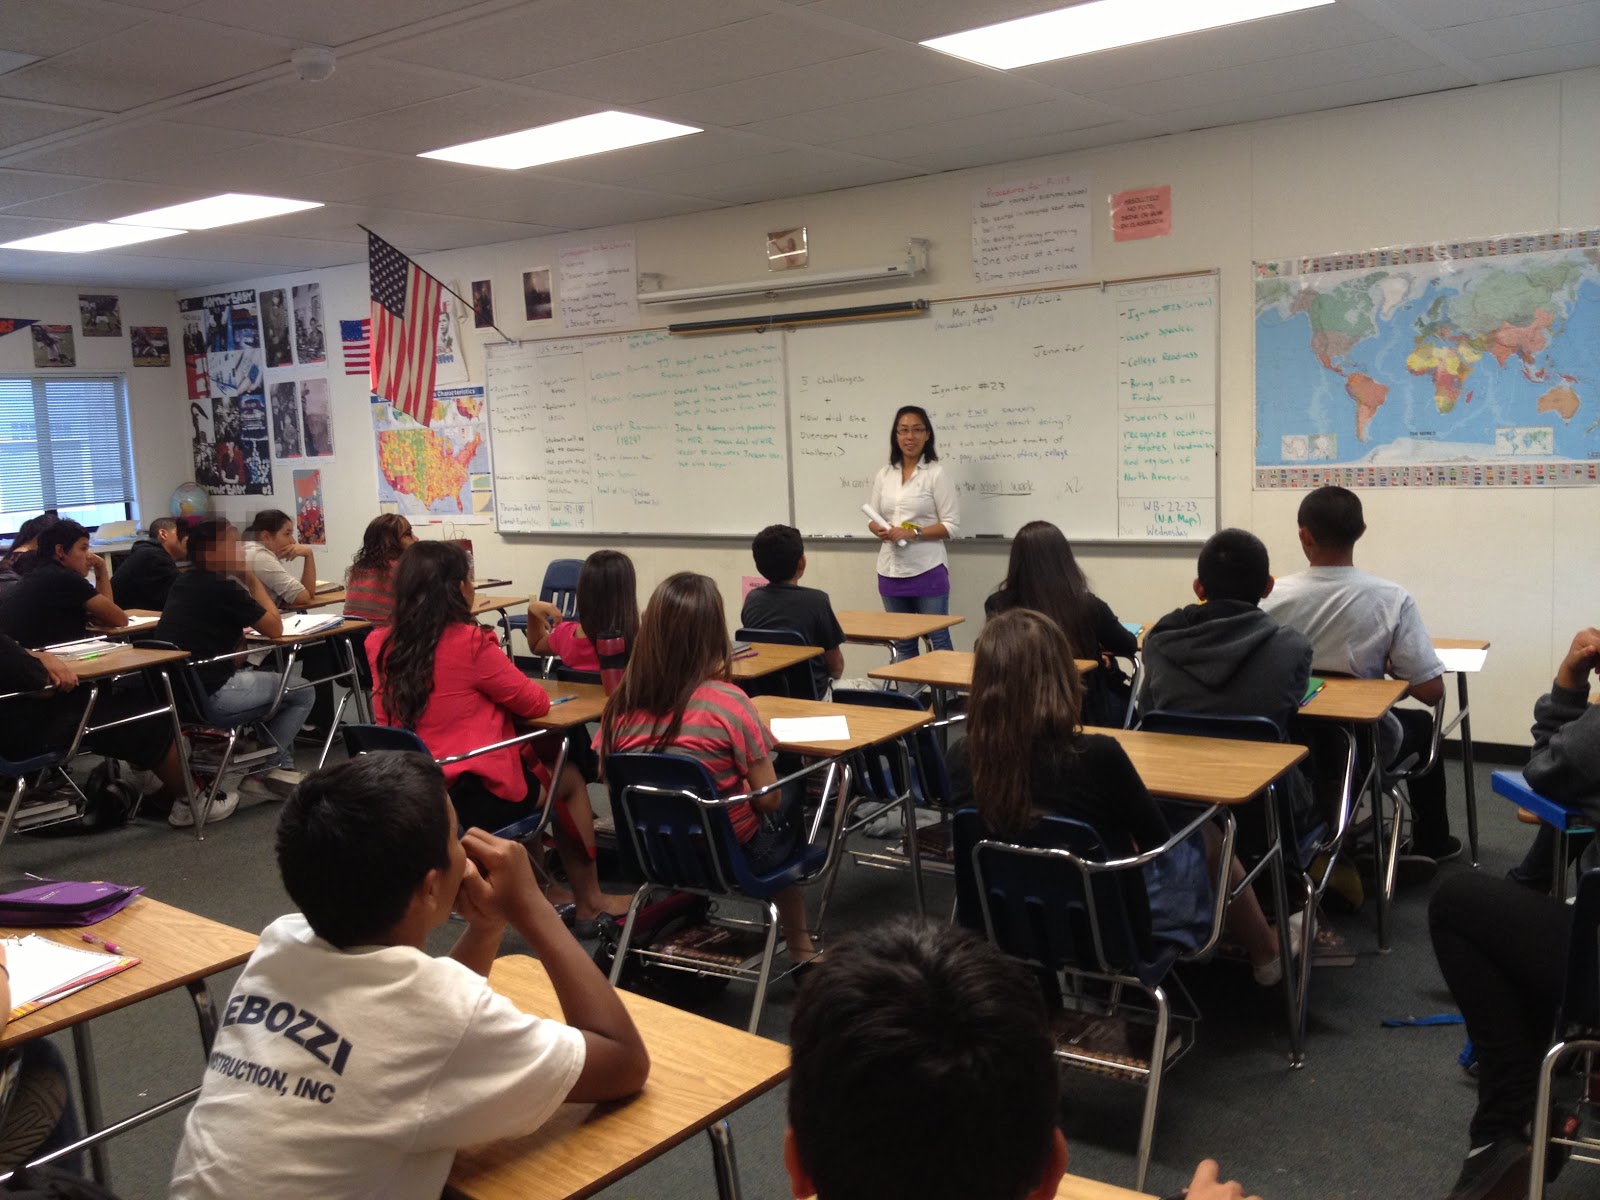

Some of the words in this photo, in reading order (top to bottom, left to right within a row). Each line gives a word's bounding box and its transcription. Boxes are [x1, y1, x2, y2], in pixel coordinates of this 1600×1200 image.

[982, 257, 1001, 266] One
[436, 389, 476, 397] Characteristics
[293, 1077, 336, 1104] INC
